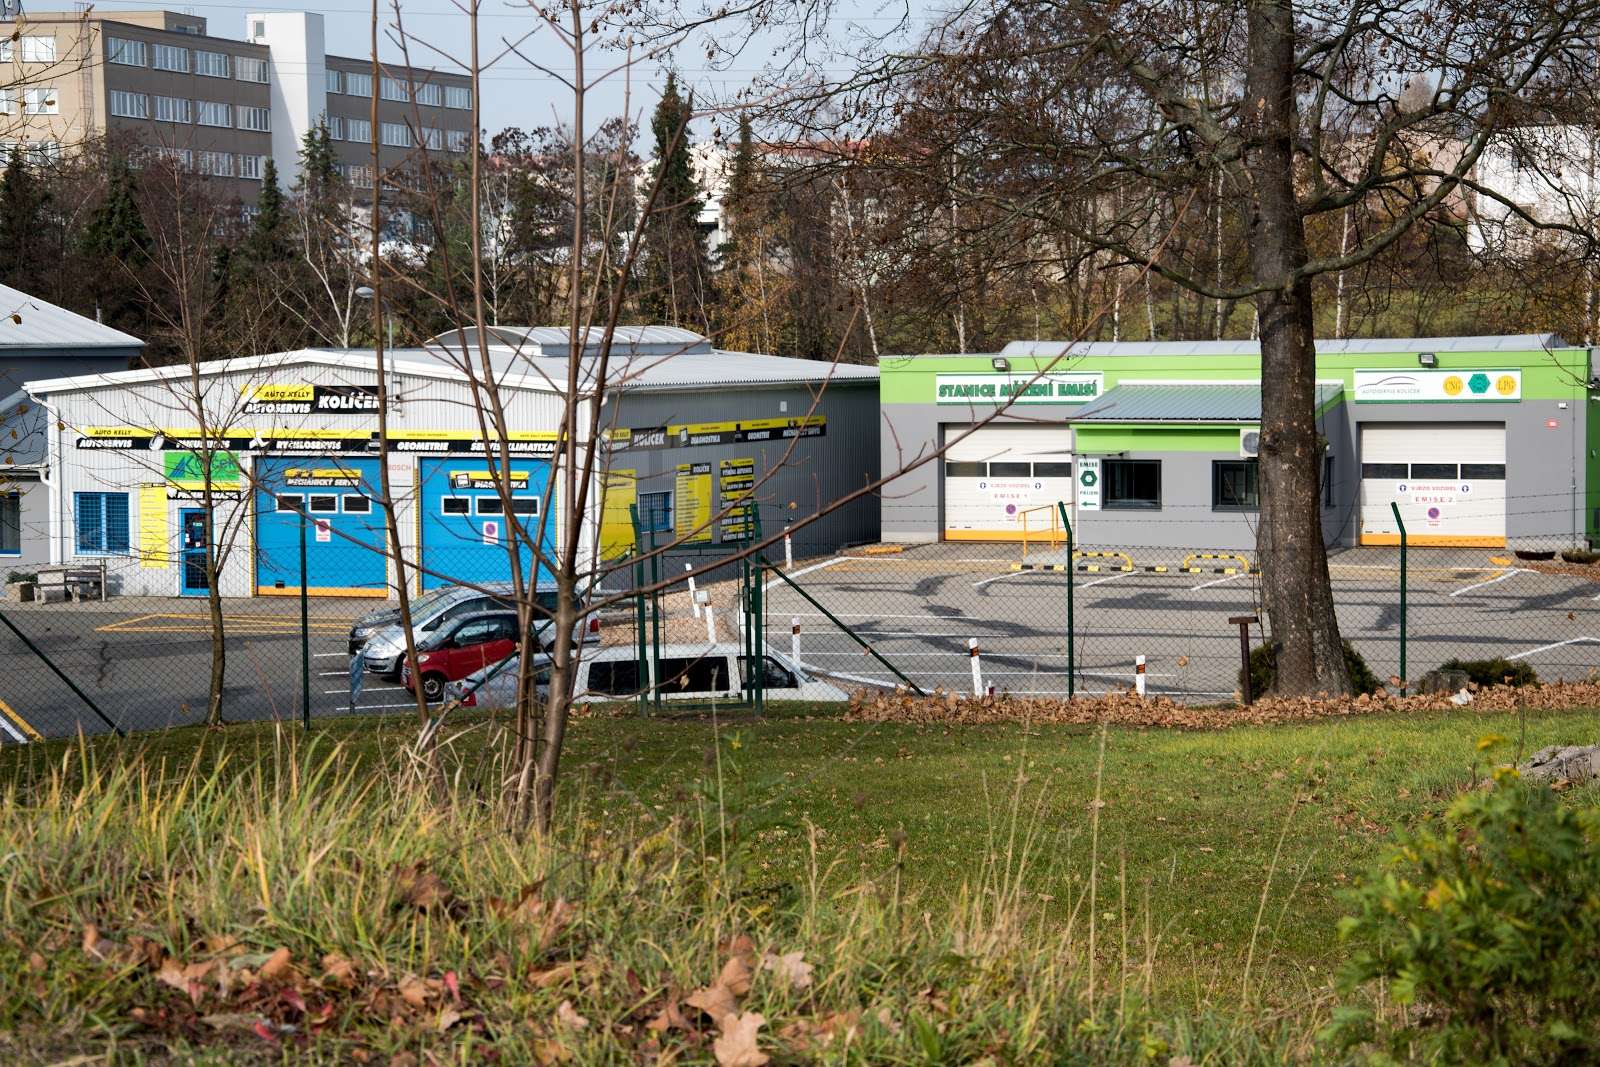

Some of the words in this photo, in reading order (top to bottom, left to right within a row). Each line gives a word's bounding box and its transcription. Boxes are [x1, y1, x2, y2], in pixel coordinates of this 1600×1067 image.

[938, 384, 996, 397] STANICE
[1058, 379, 1098, 396] EMISÍ
[1497, 381, 1516, 391] LPG
[245, 403, 311, 414] AUTOSERVIS
[634, 430, 665, 447] KOLÍČEK
[79, 439, 132, 449] AUTOSERVIS
[276, 440, 342, 450] RYCHLOSERVIS
[397, 441, 449, 451] GEOMETRIE
[471, 441, 501, 451] SEVIS
